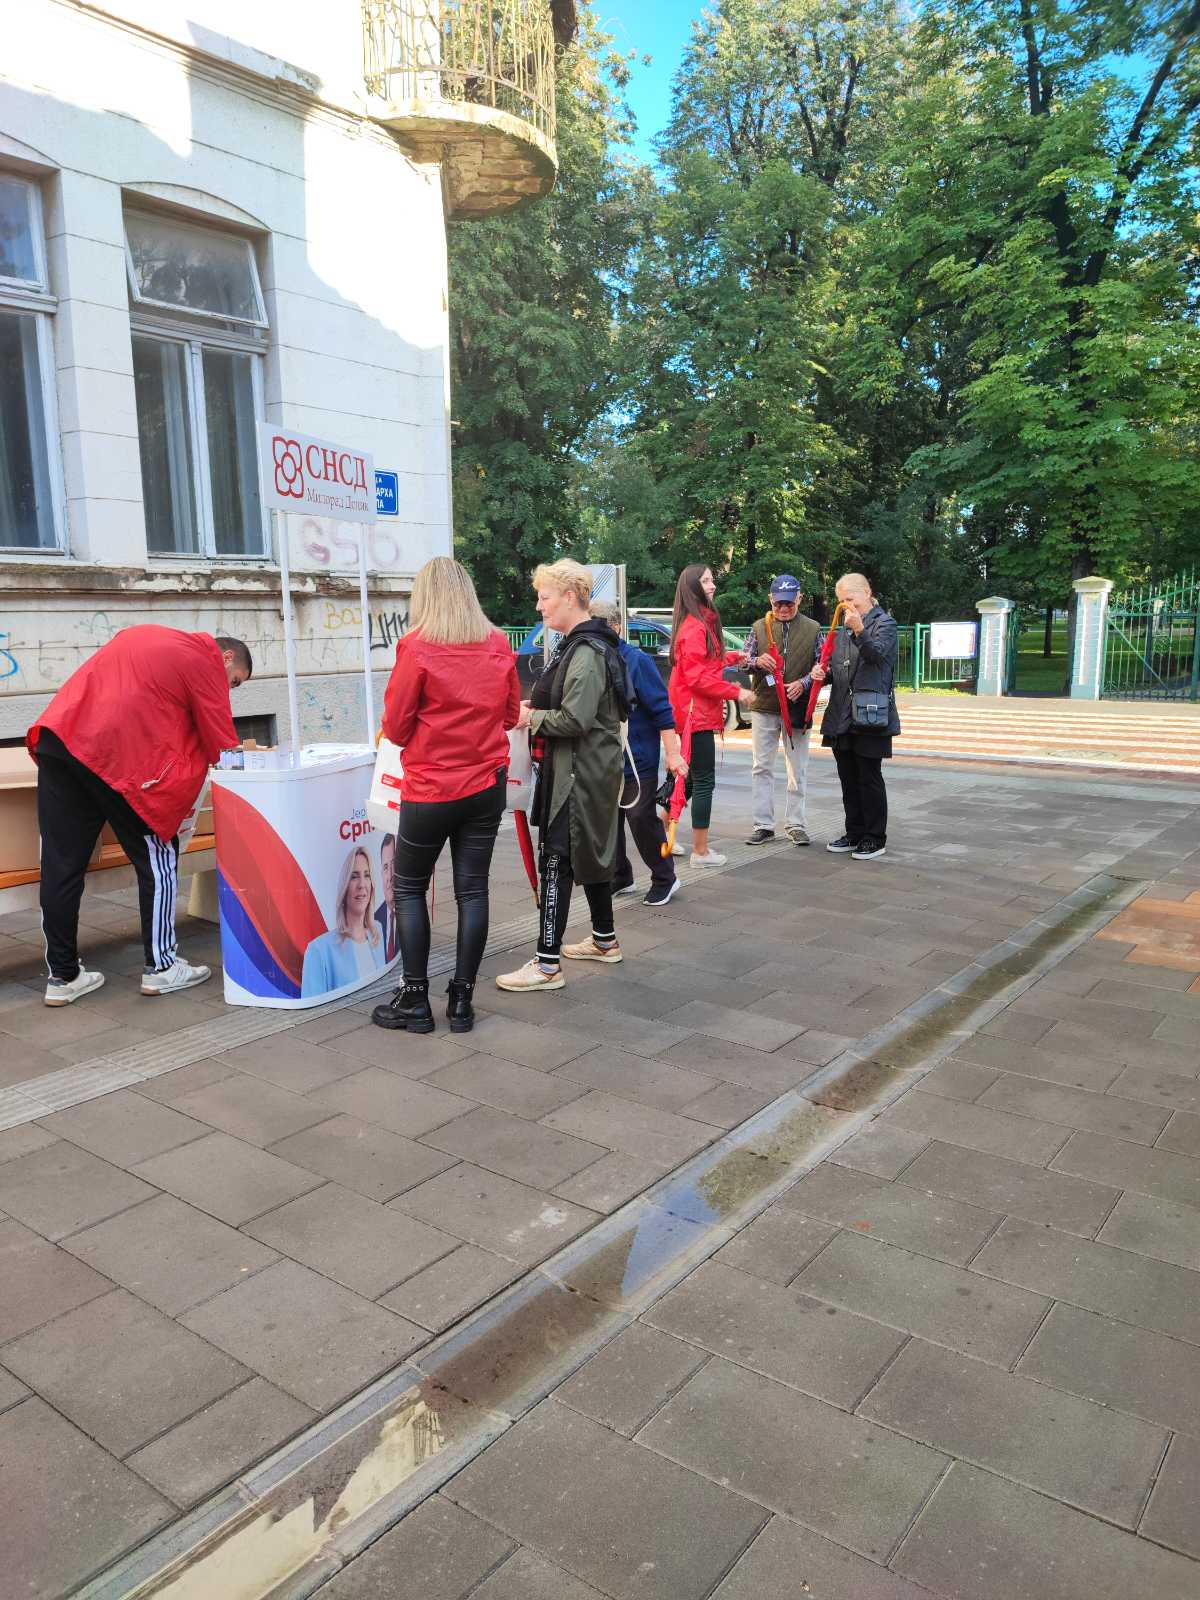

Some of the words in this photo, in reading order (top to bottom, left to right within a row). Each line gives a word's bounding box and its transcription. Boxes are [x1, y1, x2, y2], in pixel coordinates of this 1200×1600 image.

[305, 444, 368, 497] СНСД
[376, 487, 394, 499] АРХА
[339, 819, 376, 843] Срп
